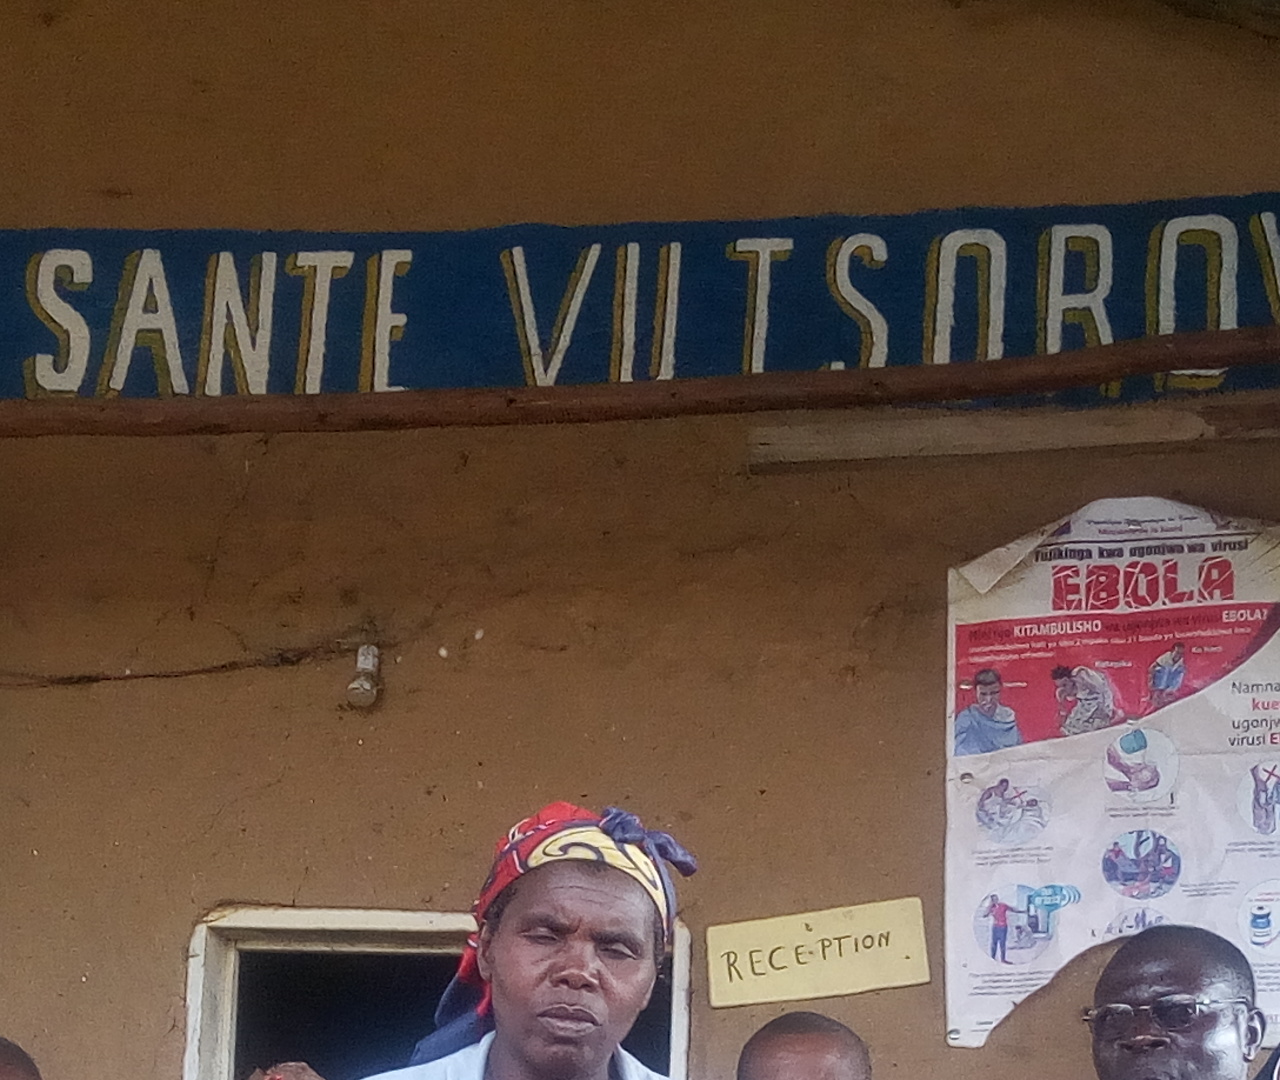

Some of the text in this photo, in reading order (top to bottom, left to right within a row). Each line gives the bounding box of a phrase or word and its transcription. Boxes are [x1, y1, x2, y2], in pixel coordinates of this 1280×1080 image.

[26, 248, 414, 396] SANTE
[1211, 538, 1249, 552] virusi
[1052, 556, 1235, 611] EBOLA
[1013, 619, 1102, 637] KITAMBULISHO
[1222, 609, 1269, 622] EBOLA?
[1228, 733, 1266, 746] virusi
